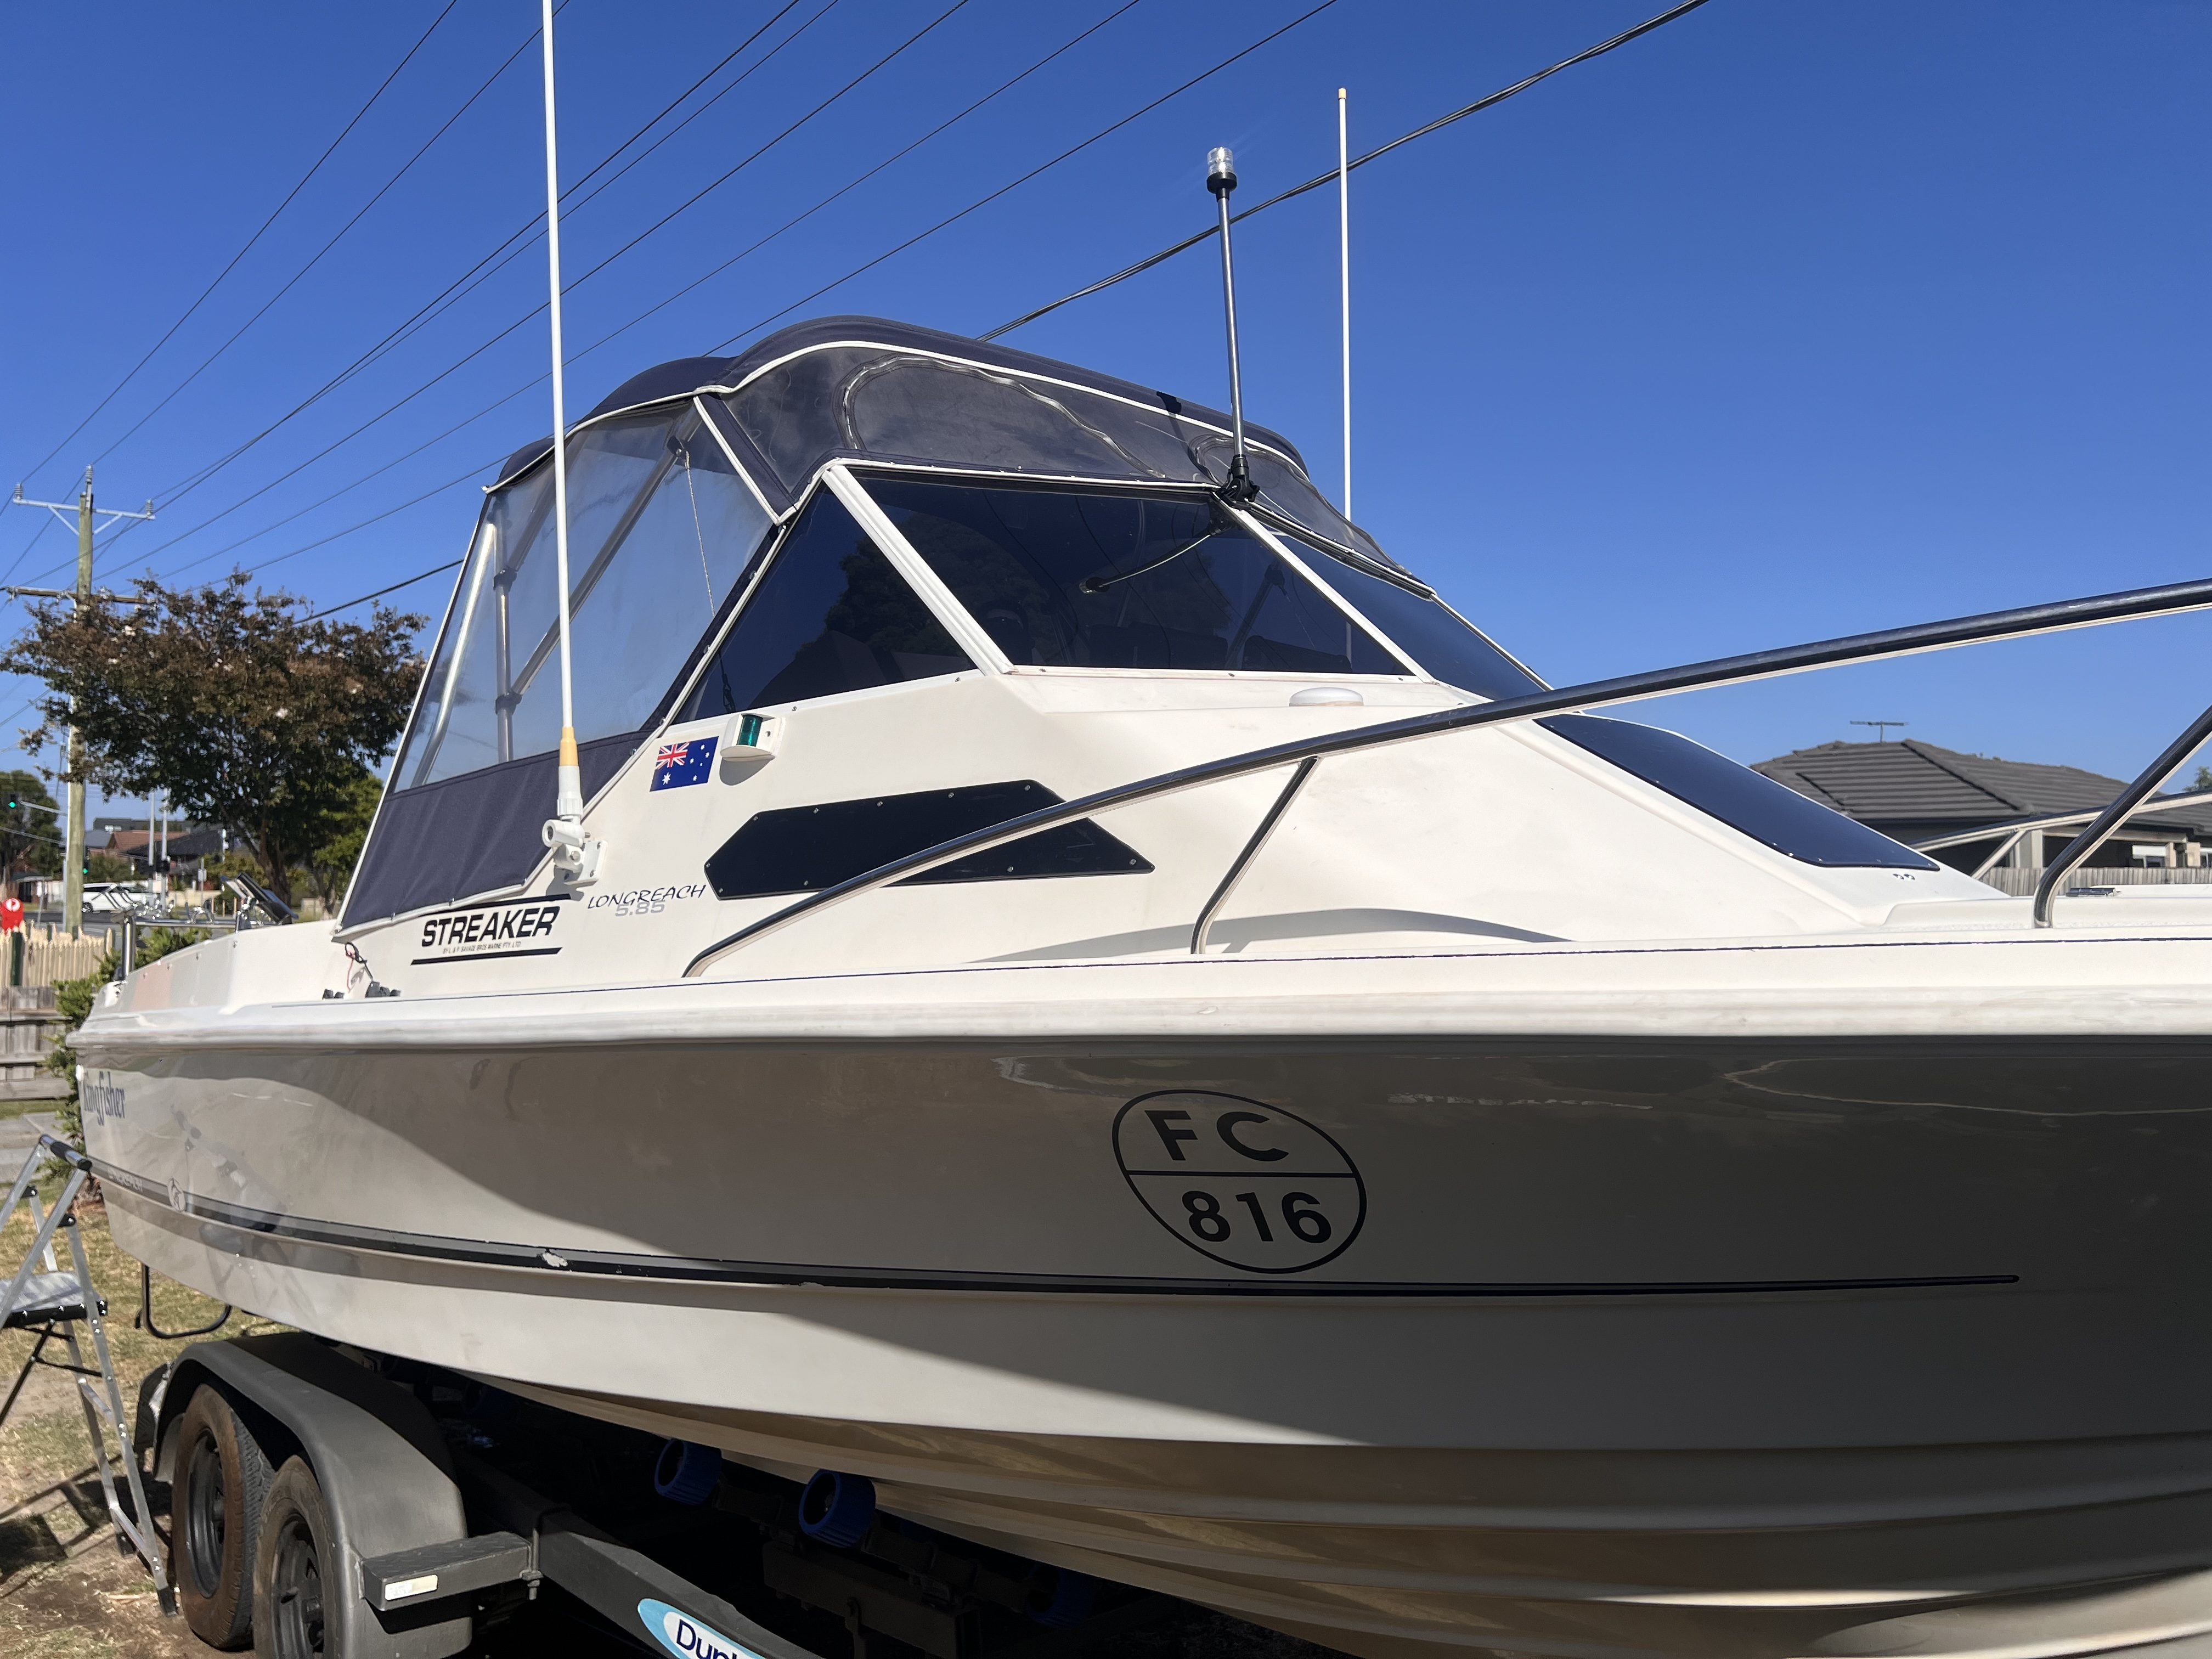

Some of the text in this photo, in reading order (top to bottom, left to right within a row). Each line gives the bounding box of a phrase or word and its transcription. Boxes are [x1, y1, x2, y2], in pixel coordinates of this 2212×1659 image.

[588, 884, 707, 909] LONGREACH
[615, 900, 666, 917] 5.85
[421, 906, 561, 947] STREAKER
[1144, 1110, 1289, 1162] FC
[1182, 1190, 1332, 1244] 816
